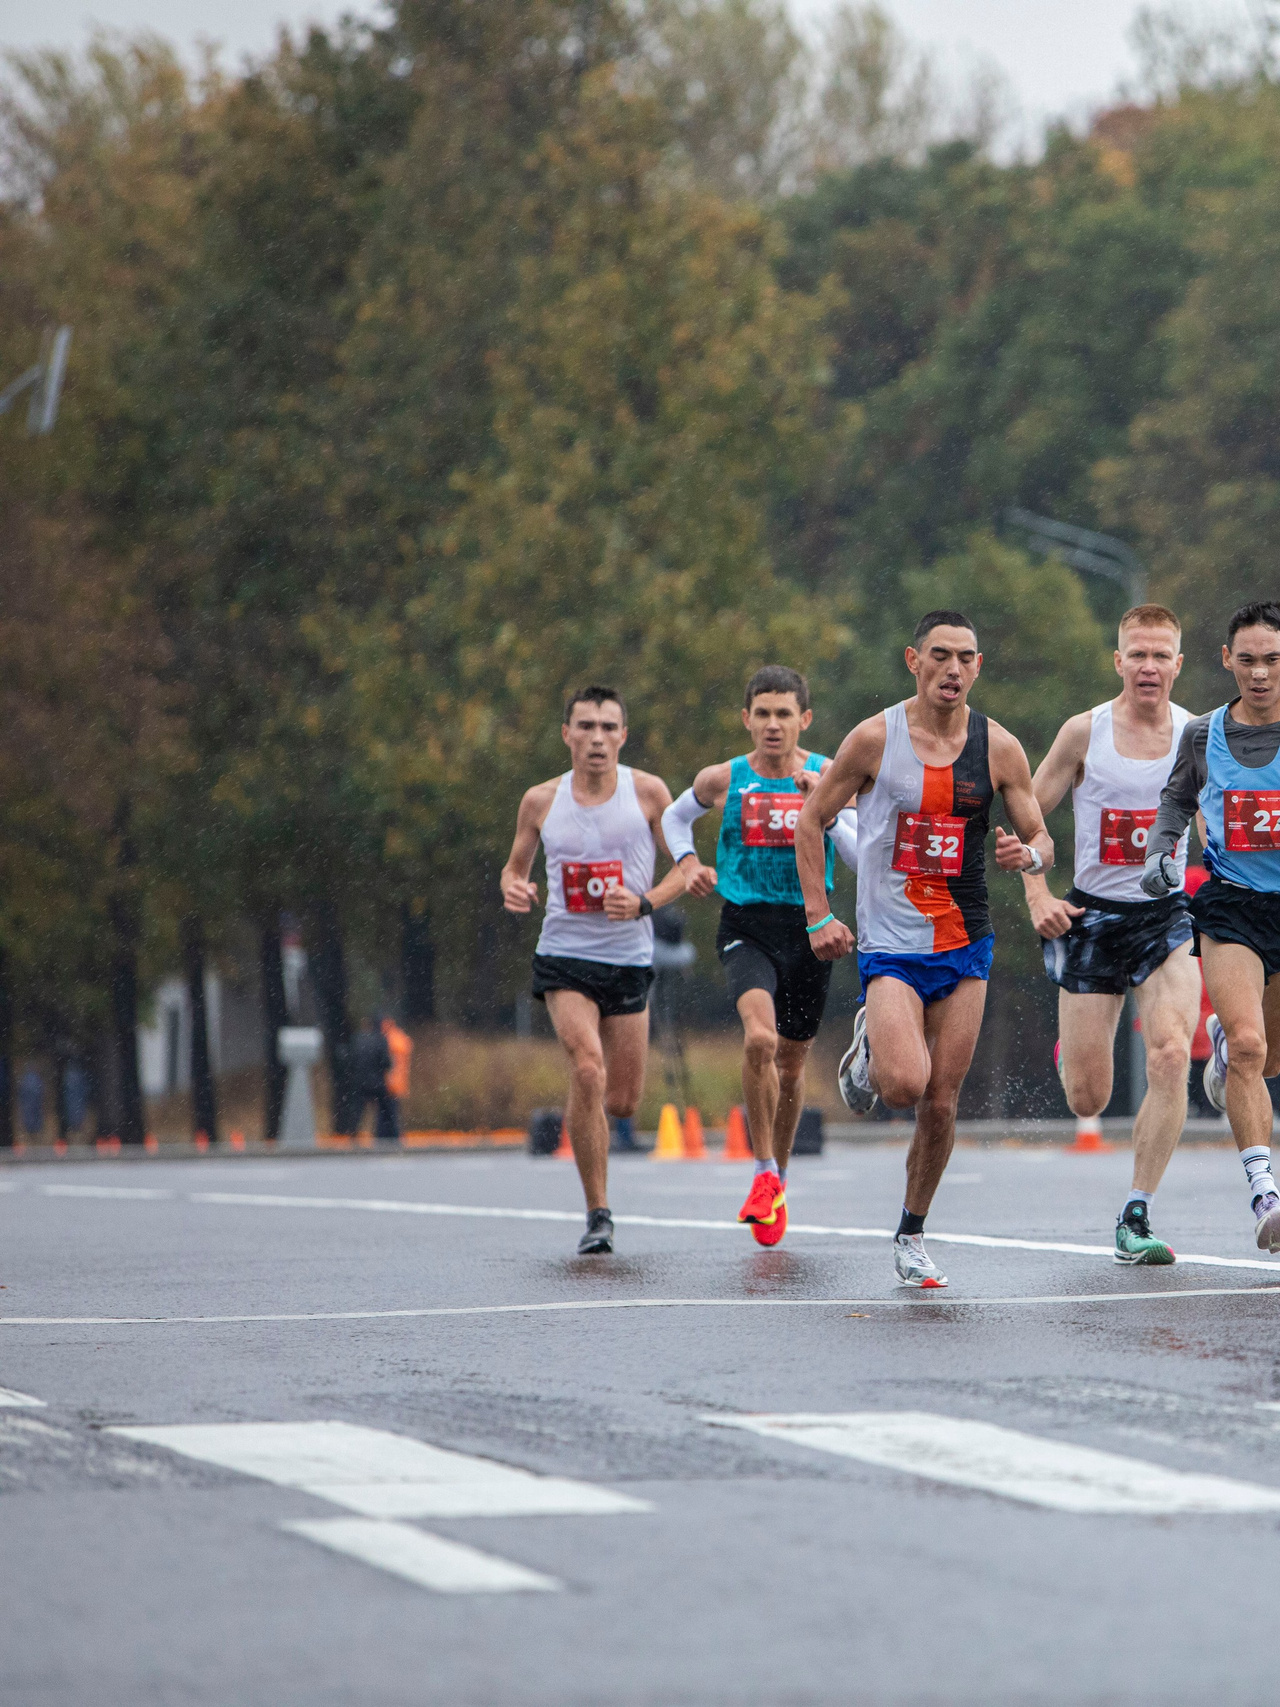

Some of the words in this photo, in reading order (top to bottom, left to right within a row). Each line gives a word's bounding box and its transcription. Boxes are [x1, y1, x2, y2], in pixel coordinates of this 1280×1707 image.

[767, 808, 800, 831] 36
[925, 834, 960, 858] 32
[1131, 827, 1149, 848] 0
